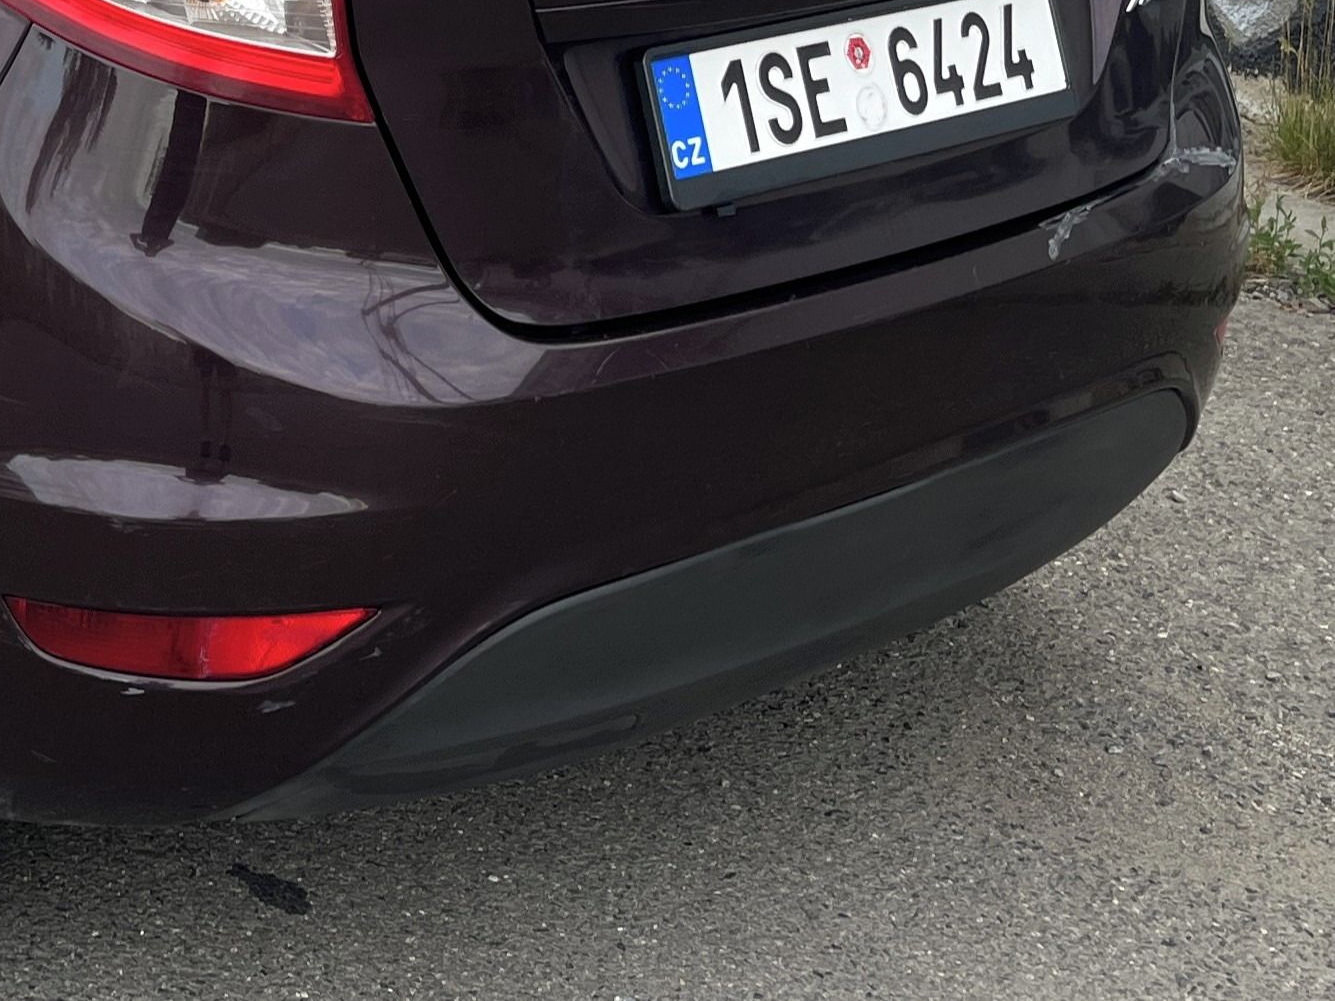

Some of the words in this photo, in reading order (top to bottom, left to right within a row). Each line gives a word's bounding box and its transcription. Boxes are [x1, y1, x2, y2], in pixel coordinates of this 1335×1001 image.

[721, 40, 848, 154] 1SE
[887, 3, 1035, 117] 6424
[671, 136, 706, 170] CZ
